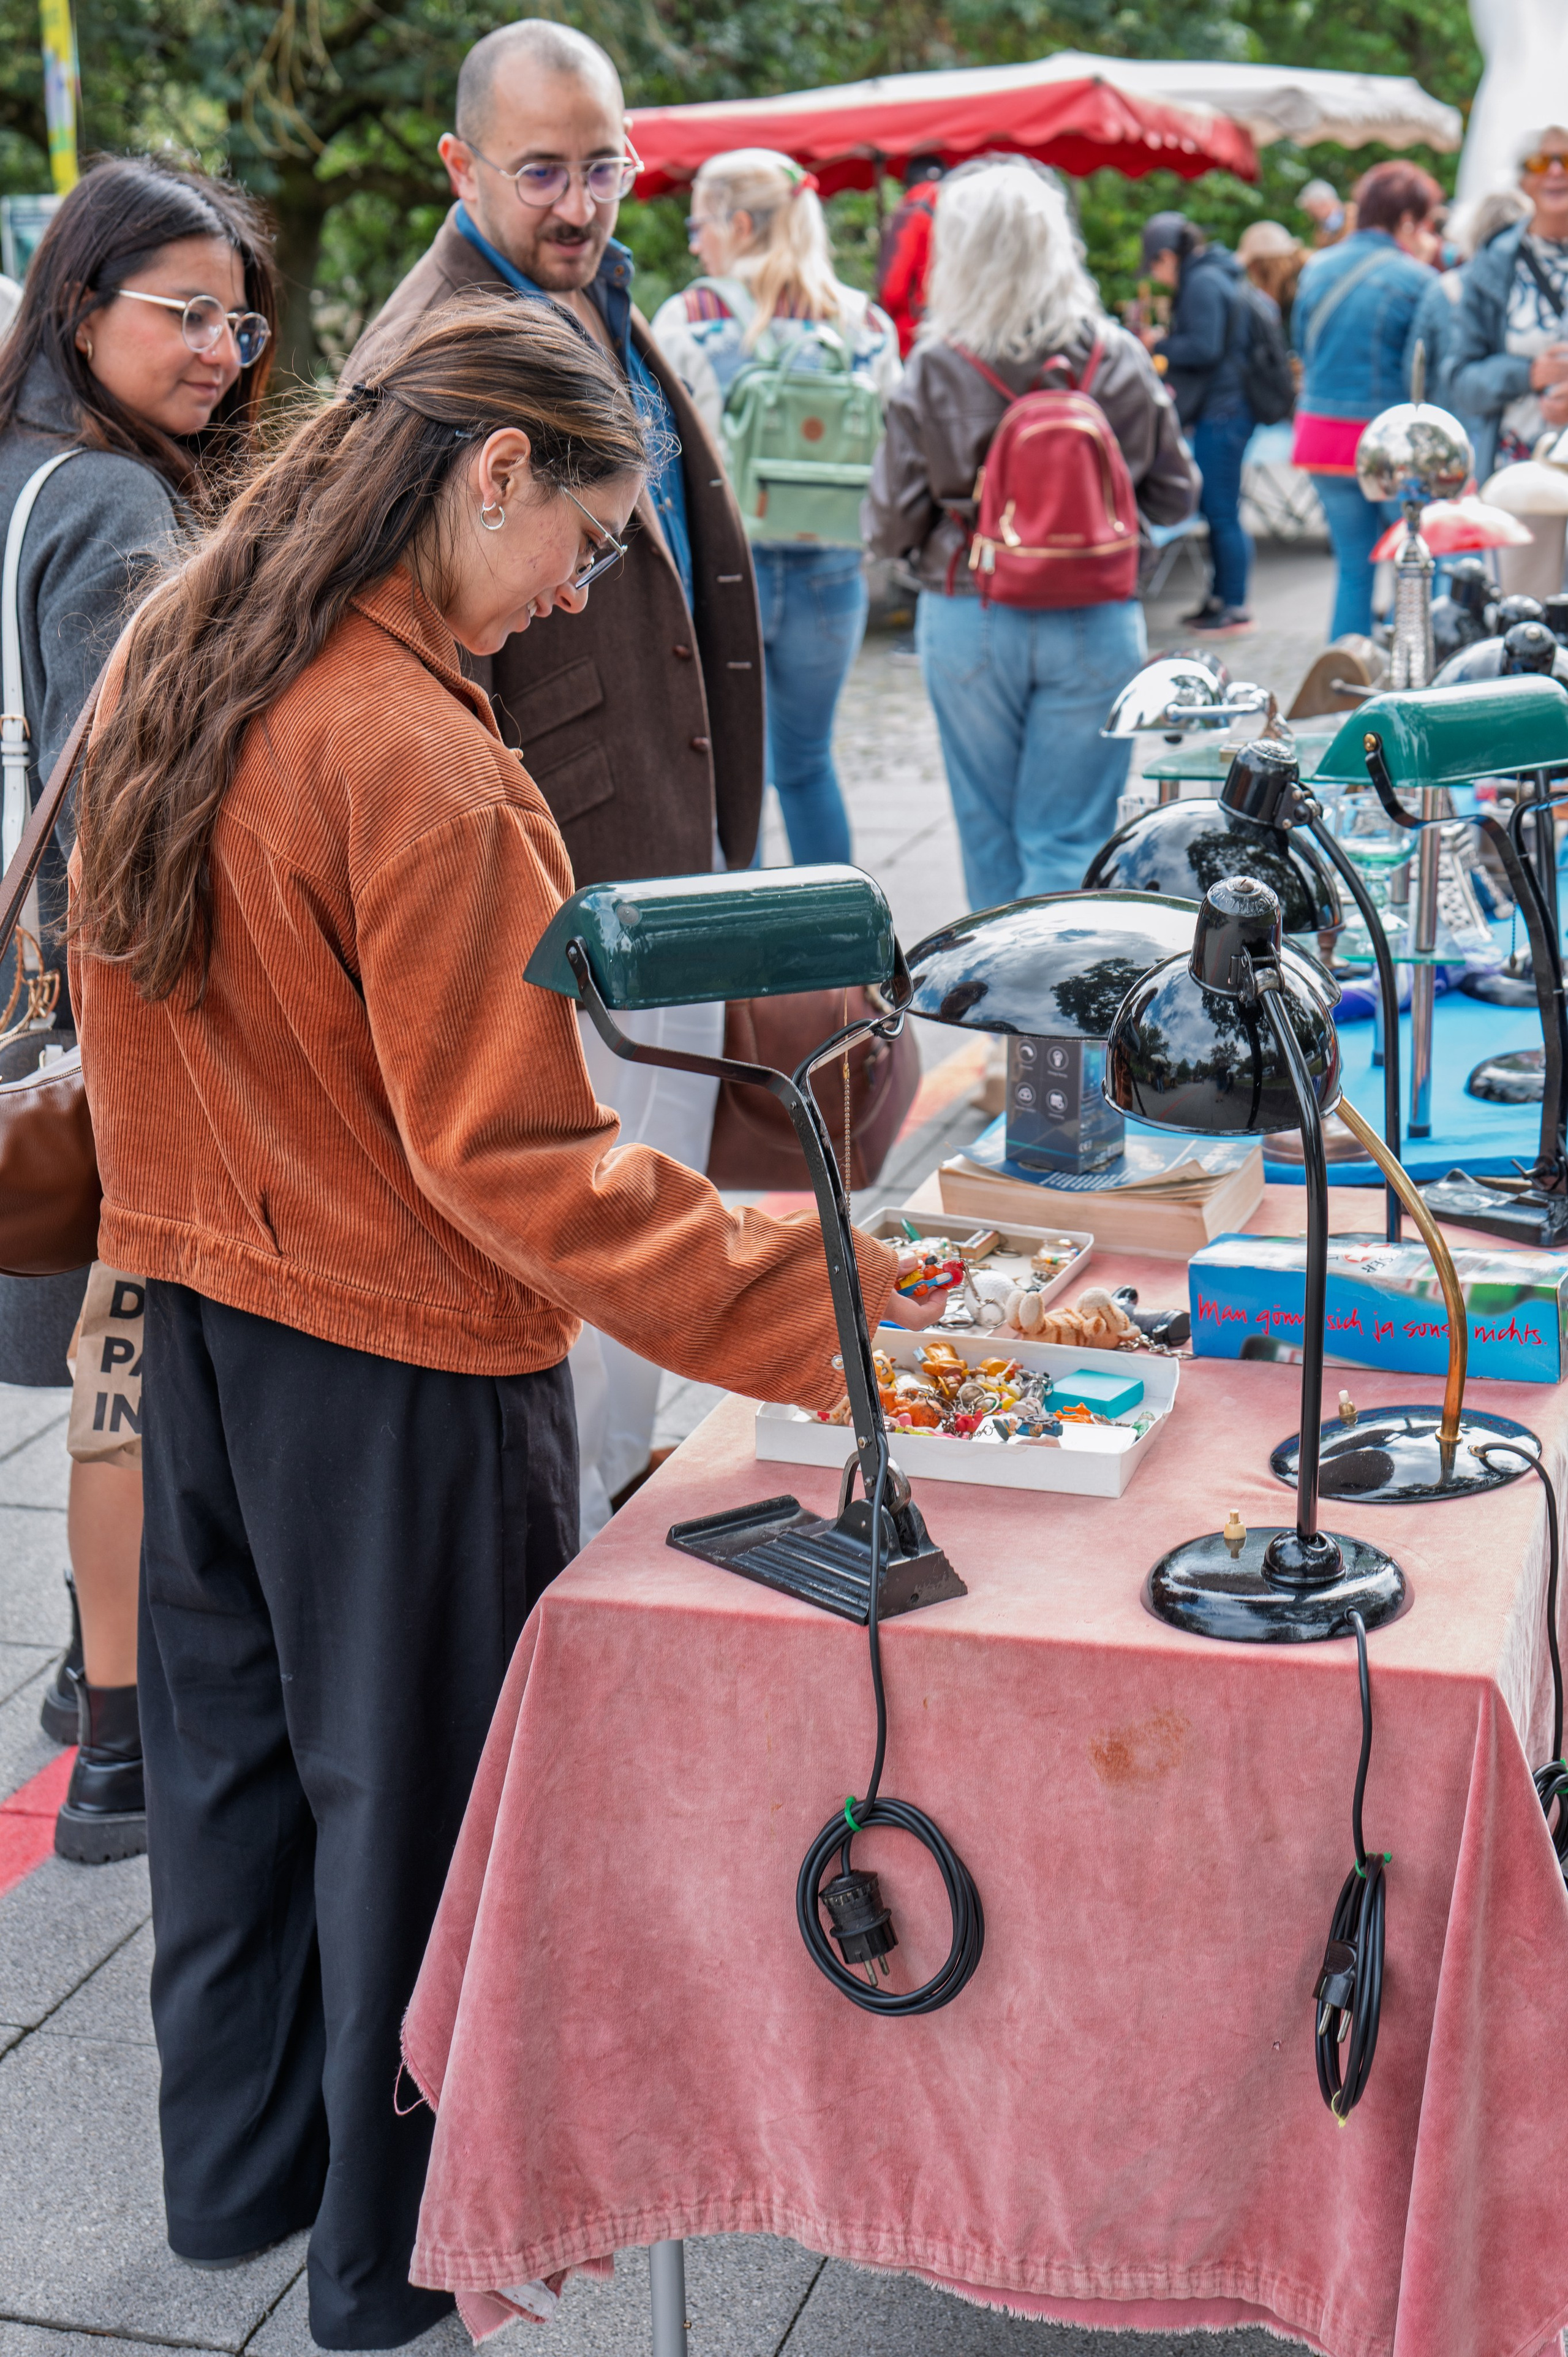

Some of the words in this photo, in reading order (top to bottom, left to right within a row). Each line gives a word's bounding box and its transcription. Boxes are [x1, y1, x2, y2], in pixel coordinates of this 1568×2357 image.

[109, 1280, 145, 1320] D
[1198, 1294, 1247, 1326] Man
[1255, 1304, 1305, 1336] gönn
[1327, 1308, 1363, 1335] sich
[1373, 1311, 1393, 1342] ja
[1402, 1320, 1449, 1338] sons
[1474, 1317, 1548, 1345] nichts.
